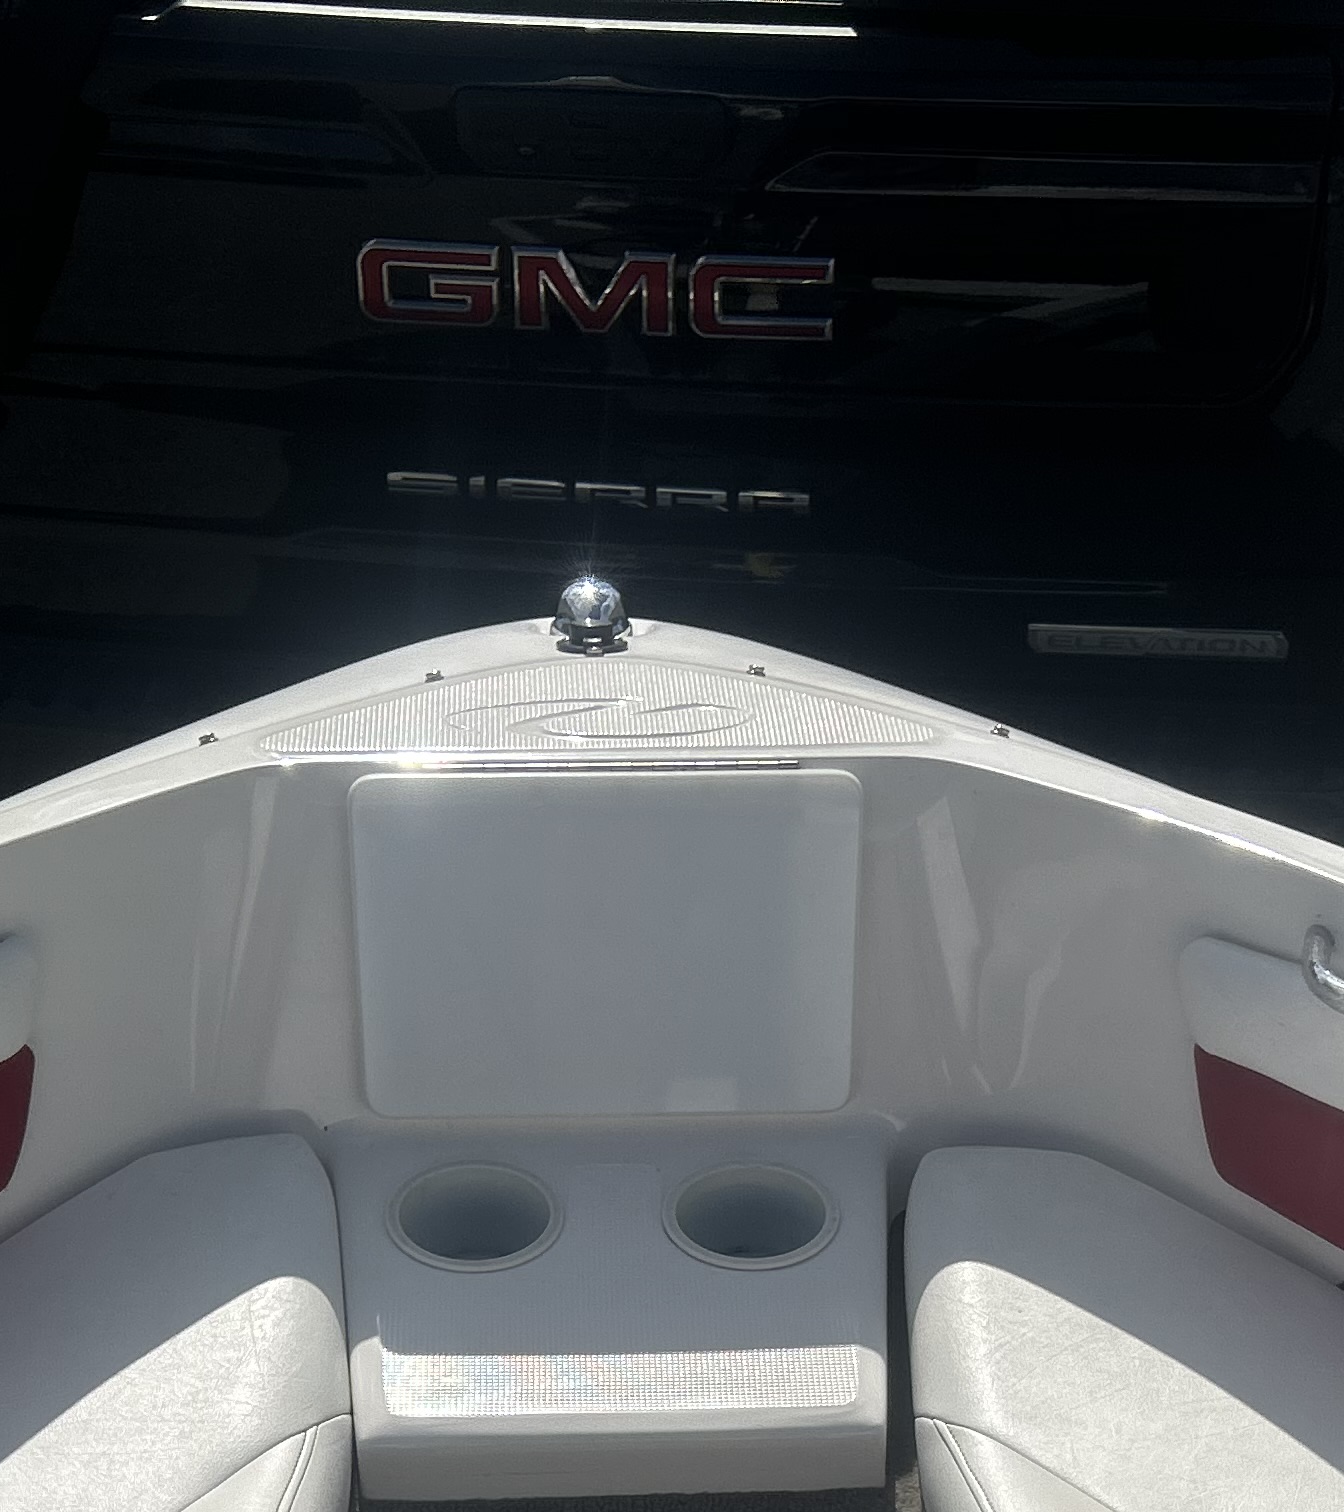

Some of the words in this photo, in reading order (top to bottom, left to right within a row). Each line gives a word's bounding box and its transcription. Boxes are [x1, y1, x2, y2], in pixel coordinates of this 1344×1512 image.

[357, 238, 835, 341] GMC
[387, 471, 810, 513] SIERRA
[1044, 631, 1270, 655] ELEVATION
